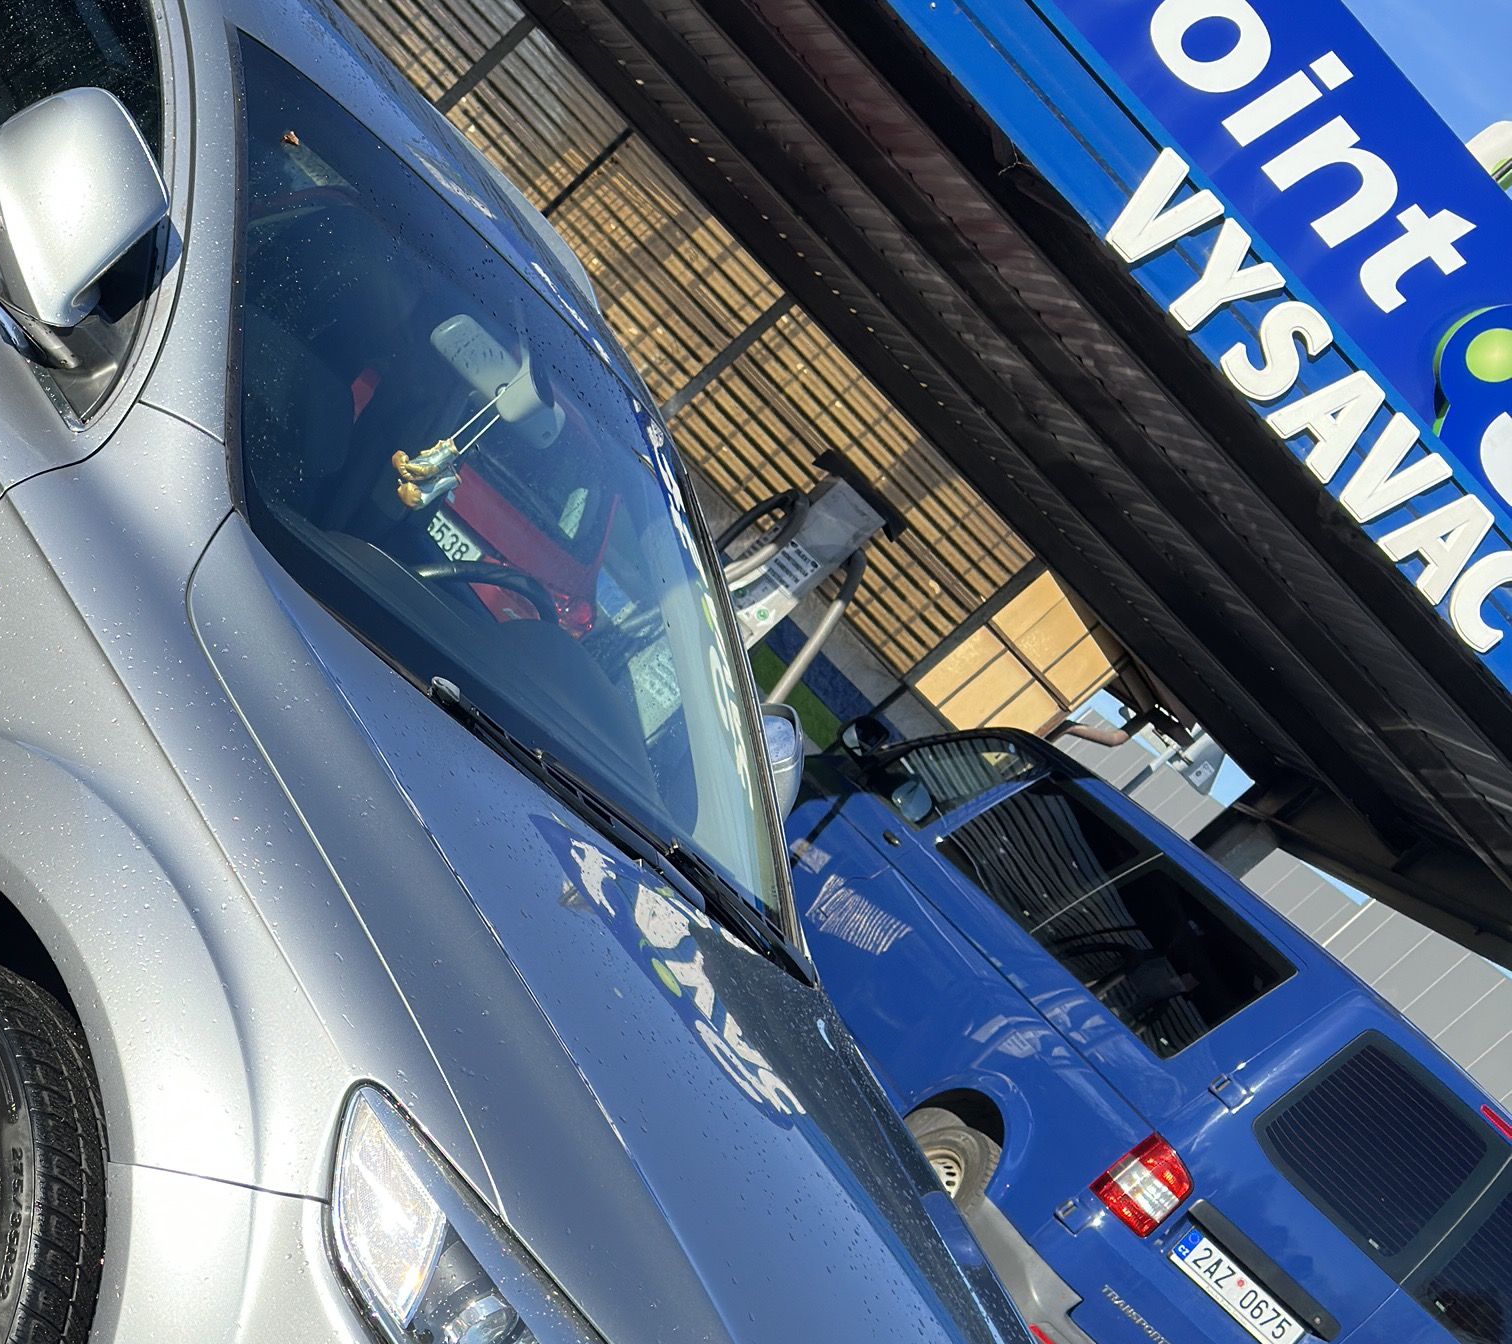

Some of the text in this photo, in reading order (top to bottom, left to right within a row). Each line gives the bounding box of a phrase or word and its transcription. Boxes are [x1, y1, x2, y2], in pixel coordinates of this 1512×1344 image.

[1178, 1244, 1190, 1256] CZ
[1192, 1247, 1236, 1290] 2AZ
[1239, 1289, 1292, 1339] 0675
